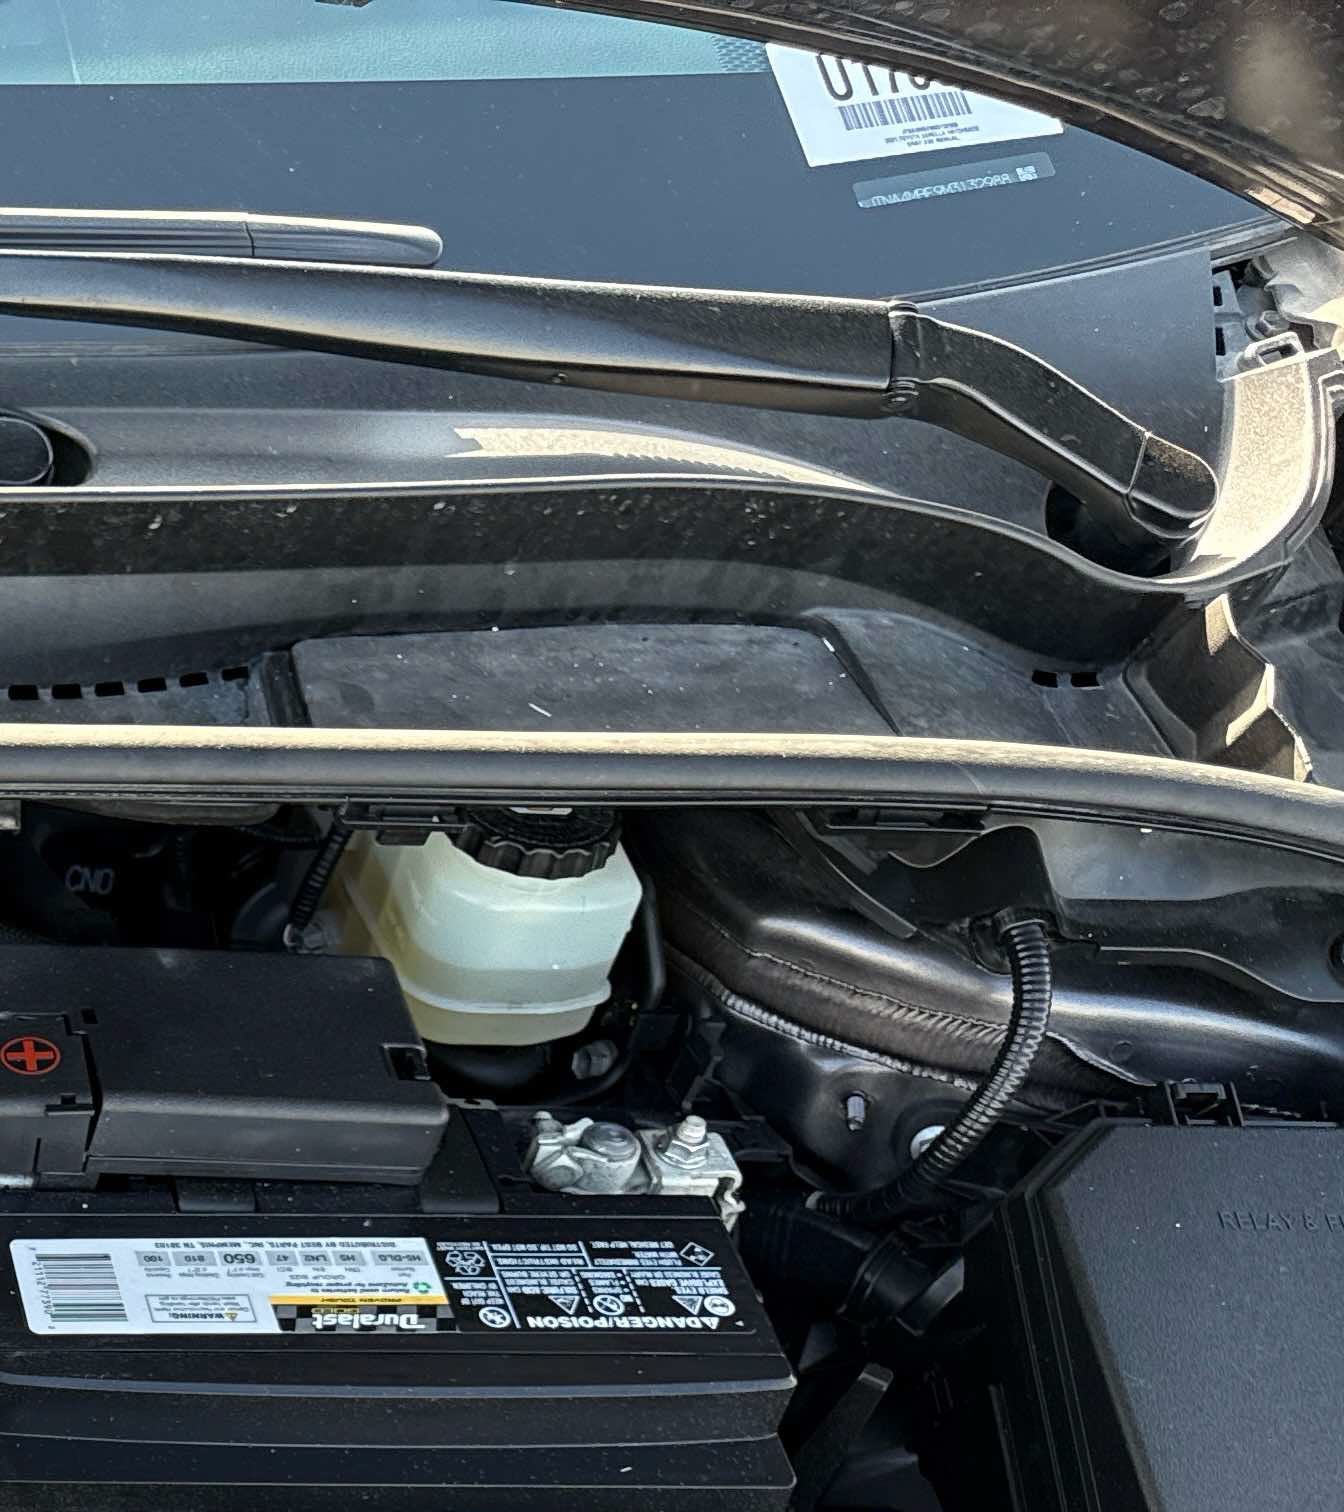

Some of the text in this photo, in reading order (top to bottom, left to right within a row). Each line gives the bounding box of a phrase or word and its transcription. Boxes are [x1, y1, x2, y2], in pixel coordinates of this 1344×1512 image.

[1217, 1211, 1291, 1231] RELAY
[223, 1253, 255, 1264] 650
[311, 1314, 426, 1329] Duralast
[526, 1316, 702, 1329] DANGER/POISON
